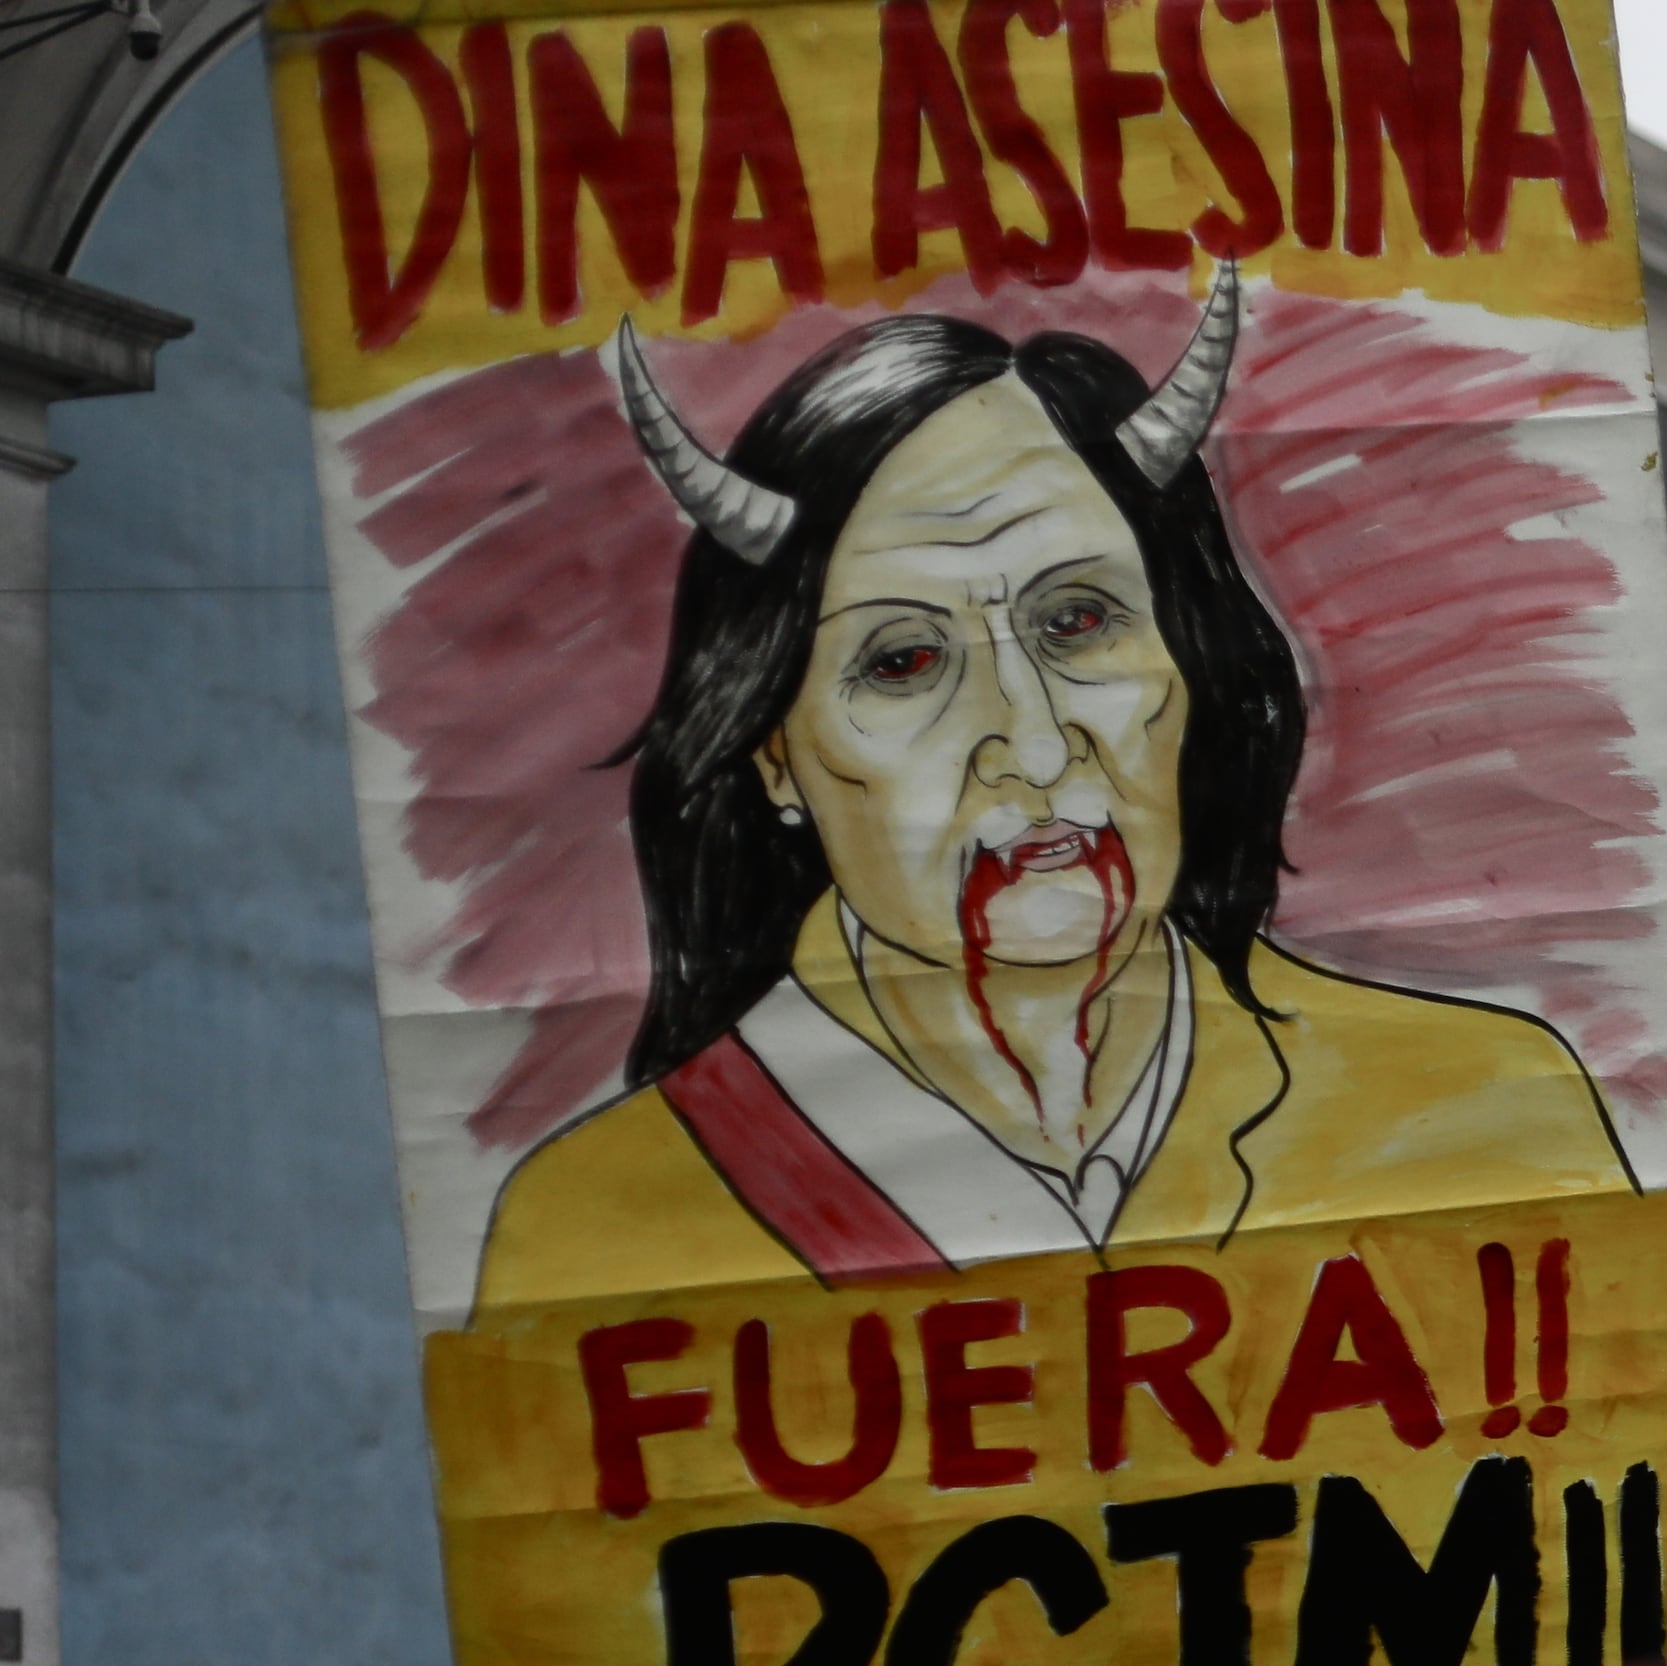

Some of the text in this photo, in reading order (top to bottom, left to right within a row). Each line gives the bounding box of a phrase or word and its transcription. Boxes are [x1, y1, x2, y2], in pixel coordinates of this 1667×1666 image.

[316, 0, 1608, 351] DINA ASESINA
[578, 1237, 1571, 1519] FUERA!!
